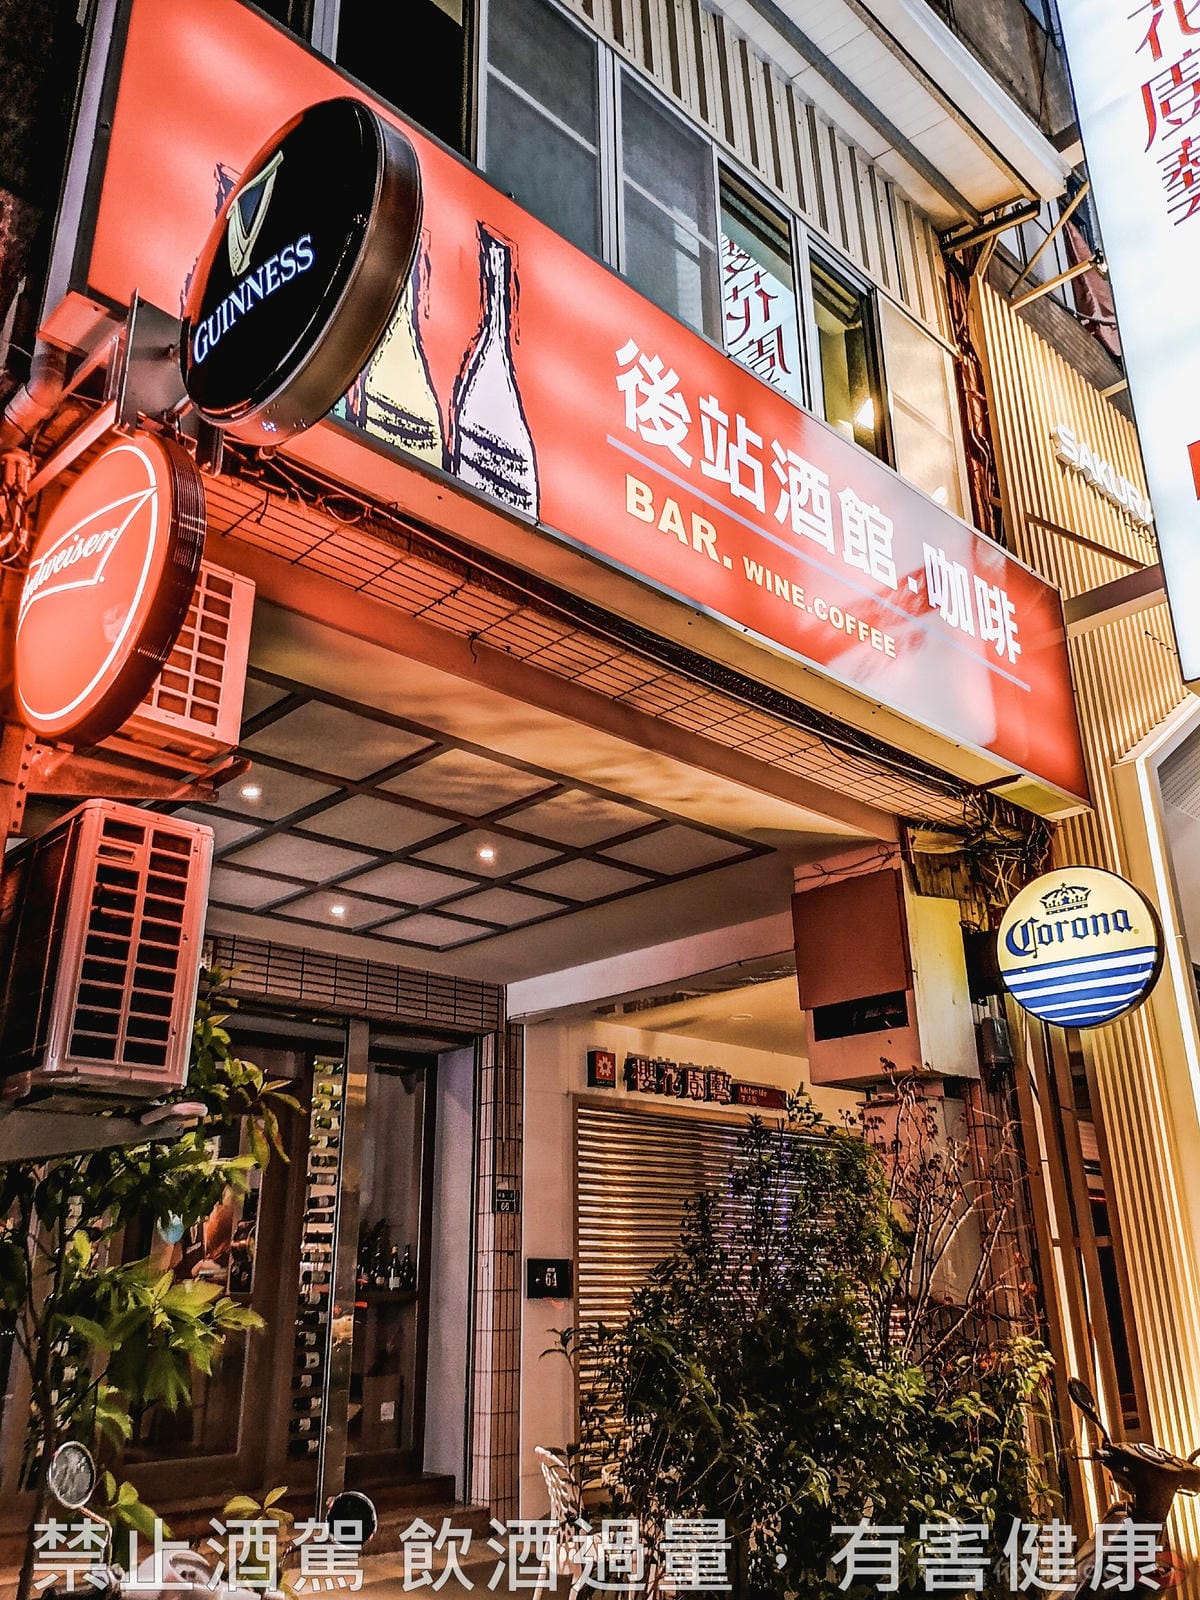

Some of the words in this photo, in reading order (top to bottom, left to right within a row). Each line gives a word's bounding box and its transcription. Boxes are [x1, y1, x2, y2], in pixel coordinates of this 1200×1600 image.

[194, 233, 314, 364] GUINNESS
[626, 473, 732, 570] BAR.
[1006, 909, 1133, 958] Corona
